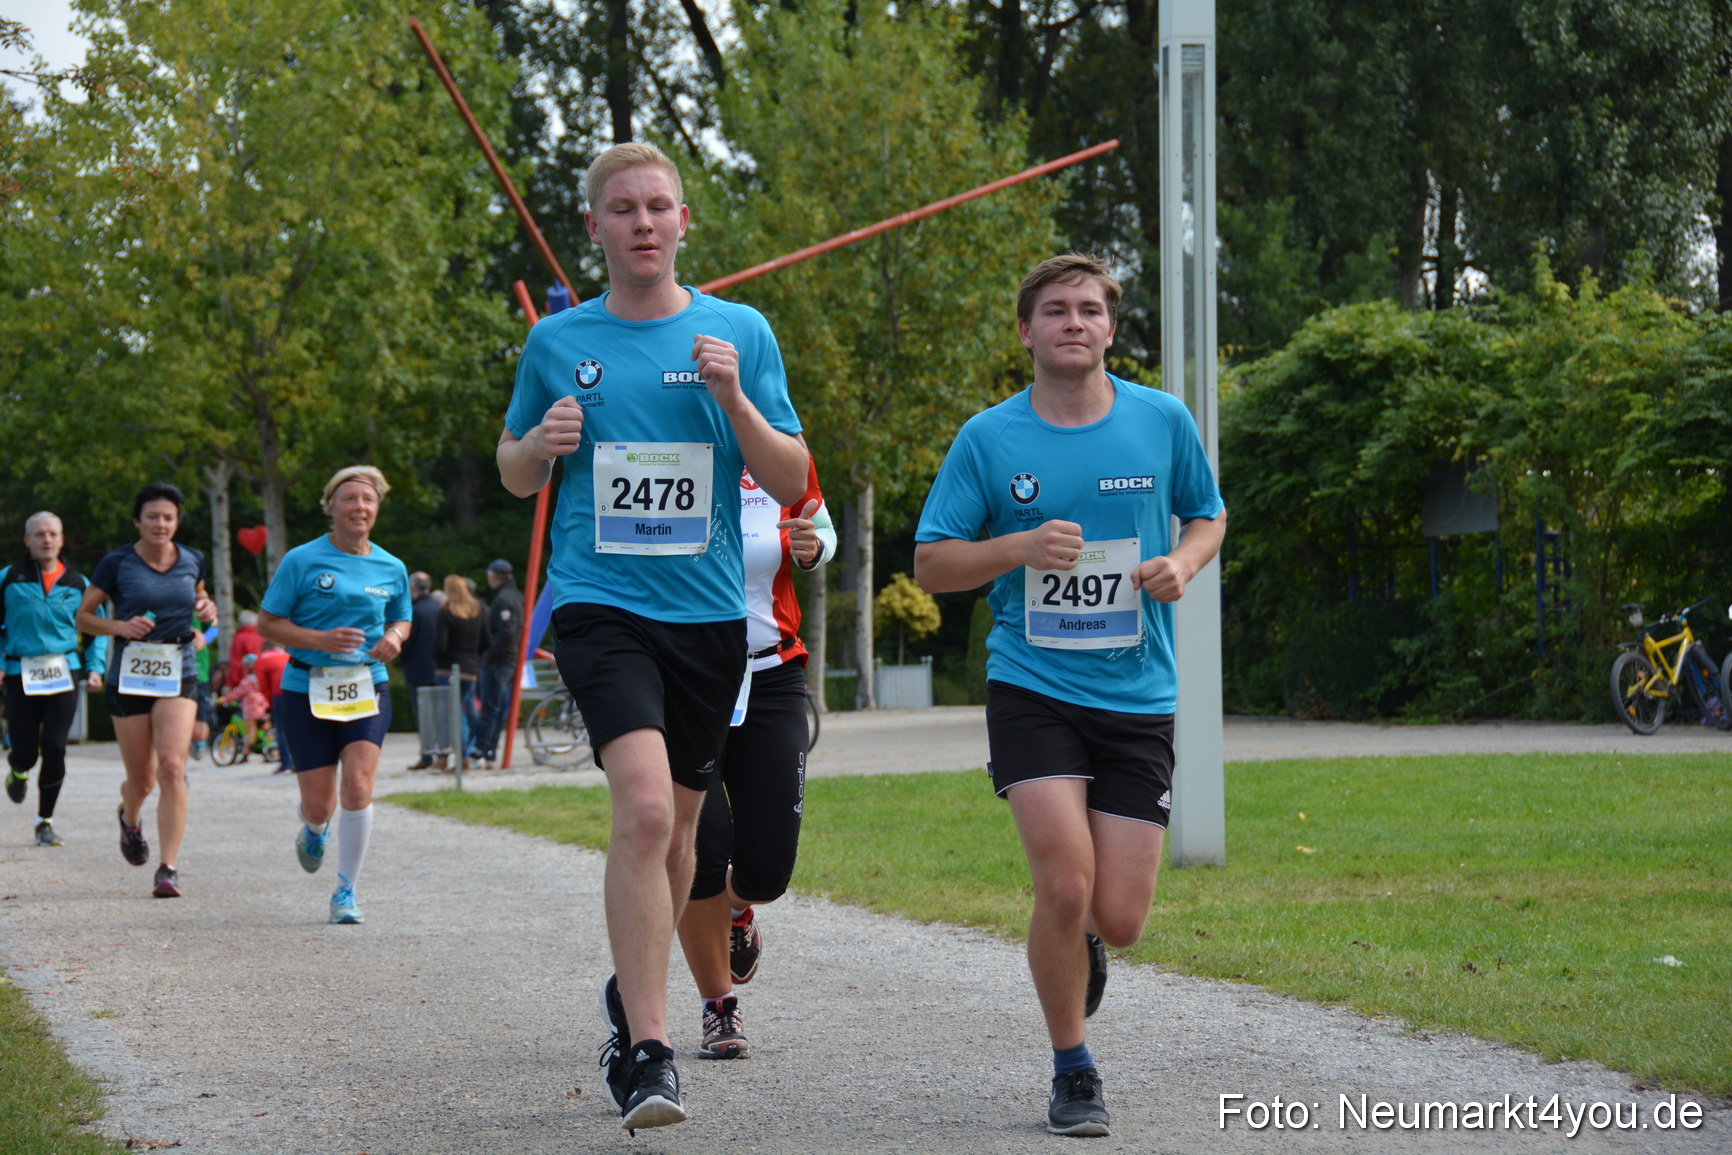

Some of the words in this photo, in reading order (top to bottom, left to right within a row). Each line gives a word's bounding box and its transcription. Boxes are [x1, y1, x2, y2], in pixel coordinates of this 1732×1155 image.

[663, 371, 706, 384] BOC
[576, 392, 604, 403] PARTL
[639, 453, 680, 463] BOCK
[1099, 477, 1154, 491] BOCK
[611, 477, 695, 511] 2478
[1014, 507, 1044, 517] PARTL
[635, 523, 672, 536] Martin
[1077, 550, 1106, 561] OCK
[1042, 573, 1122, 607] 2497
[1058, 618, 1107, 631] Andreas
[29, 667, 62, 681] 2348
[130, 658, 172, 677] 2325
[326, 683, 358, 702] 158
